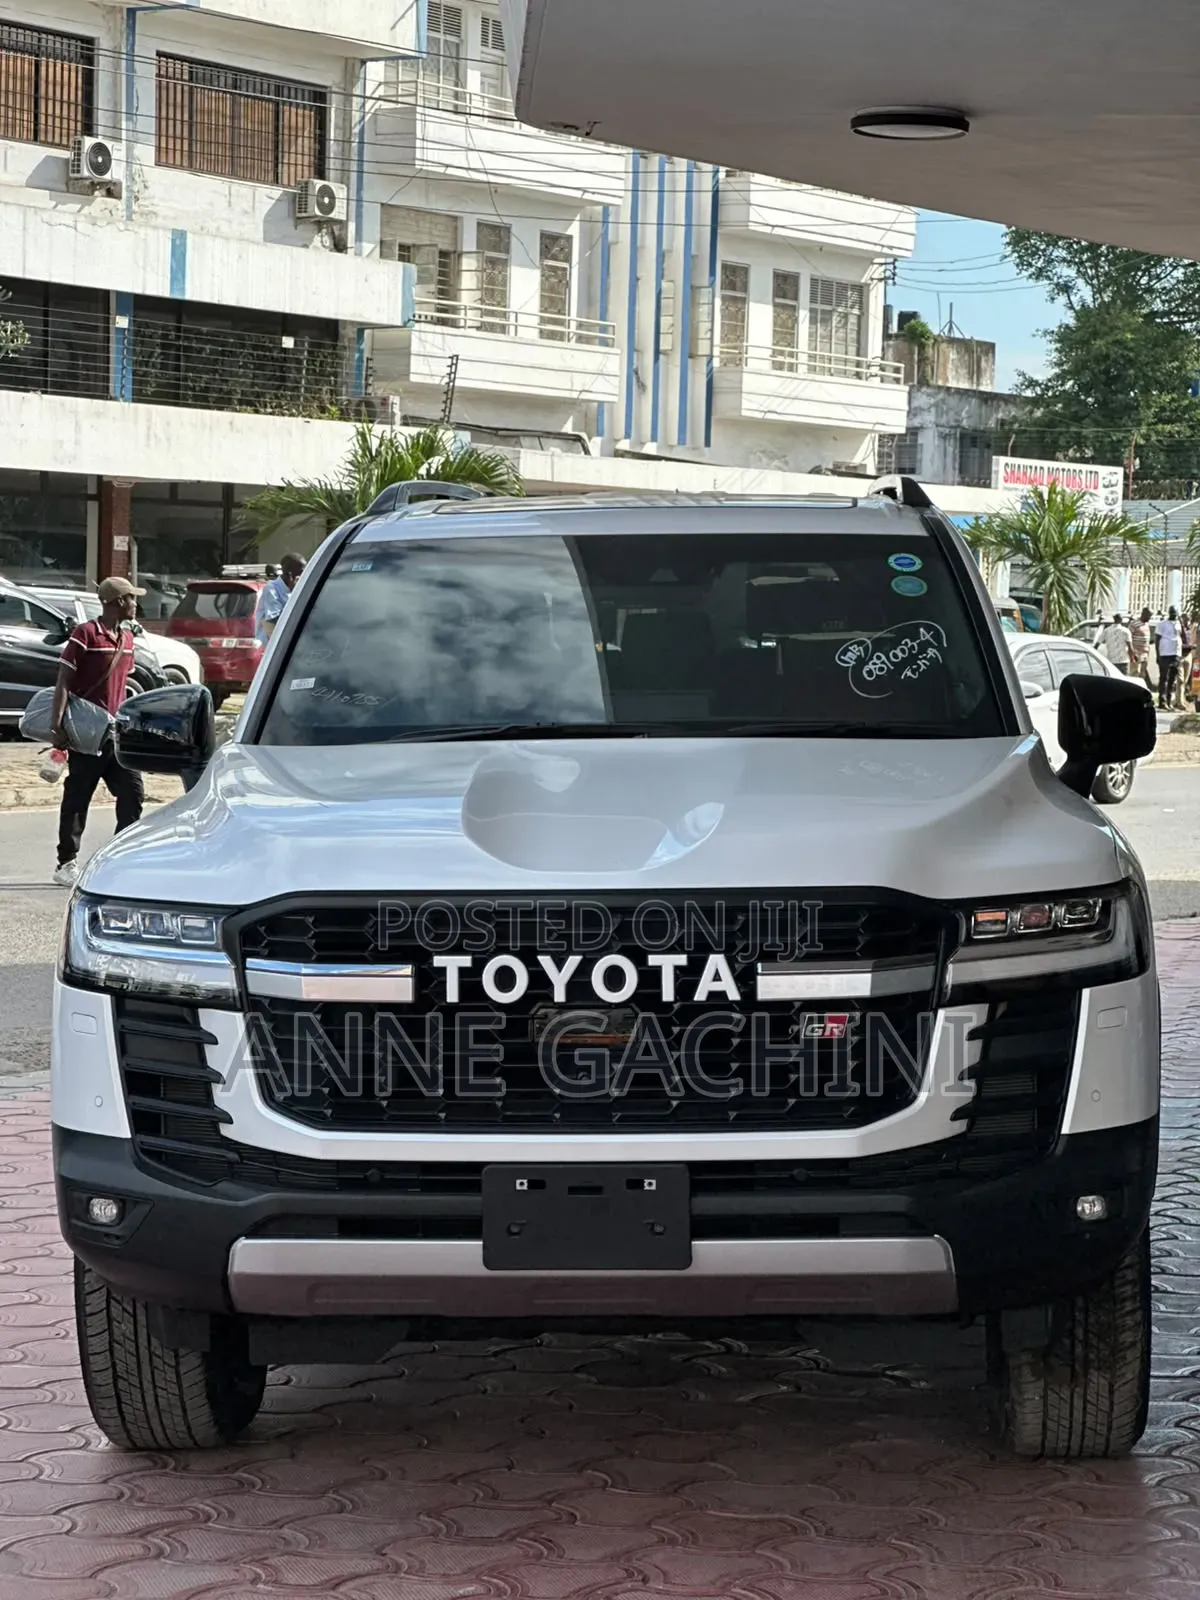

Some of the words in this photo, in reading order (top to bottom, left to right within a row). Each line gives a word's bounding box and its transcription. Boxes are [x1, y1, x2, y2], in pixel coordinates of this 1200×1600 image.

[1046, 467, 1083, 489] MOTORS
[1085, 469, 1099, 490] LTD
[433, 954, 741, 1003] TOYOTA
[805, 1023, 844, 1036] GR
